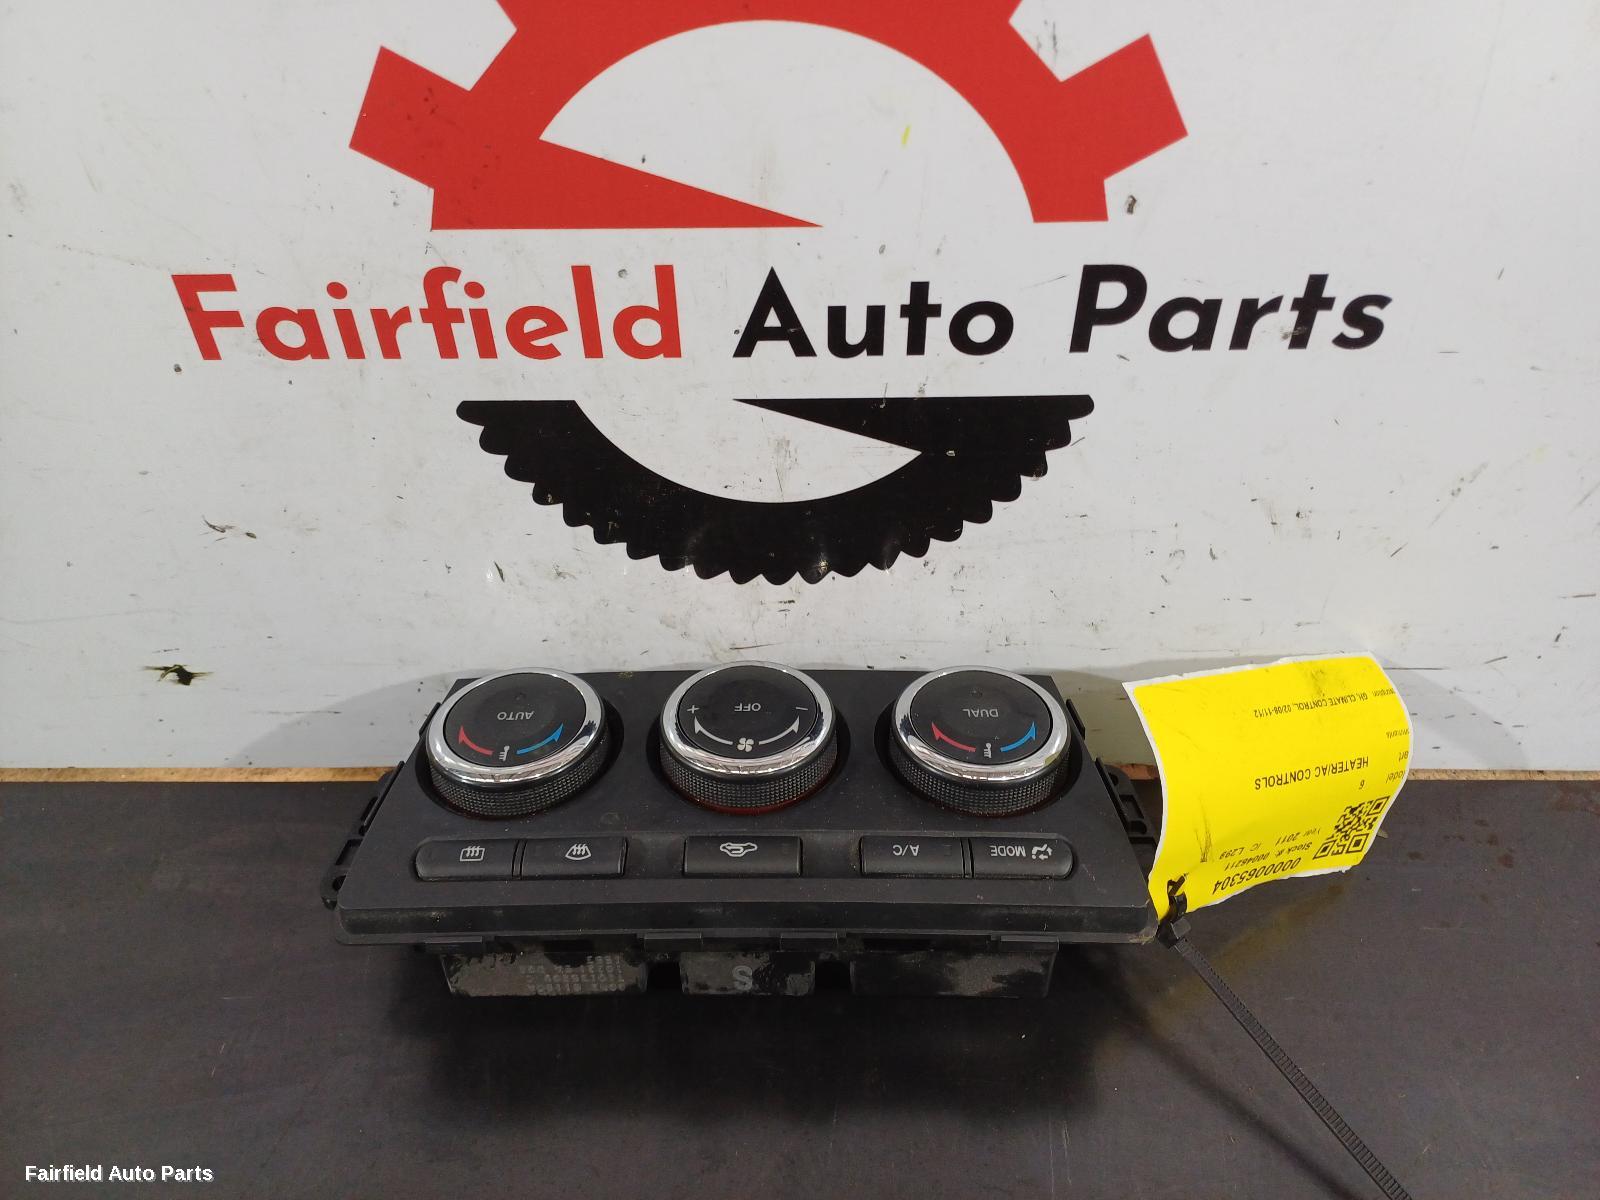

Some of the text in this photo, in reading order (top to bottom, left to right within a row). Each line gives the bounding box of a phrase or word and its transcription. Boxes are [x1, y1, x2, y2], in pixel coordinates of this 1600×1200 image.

[171, 263, 1393, 361] Fairfield Auto Parts
[1328, 694, 1356, 705] CLIMATE
[733, 702, 762, 712] OFF
[962, 708, 999, 718] DUAL
[1253, 704, 1292, 718] 02/08-11/12
[497, 710, 535, 721] AUTO
[1398, 750, 1409, 762] art
[1254, 755, 1369, 790] HEATER/AC CONTROLS
[1358, 769, 1406, 790] odel 6
[1275, 832, 1300, 847] 2011
[892, 844, 920, 857] A/C
[990, 845, 1027, 857] MODE
[1287, 841, 1313, 854] Stock
[1212, 857, 1302, 895] 0000065304
